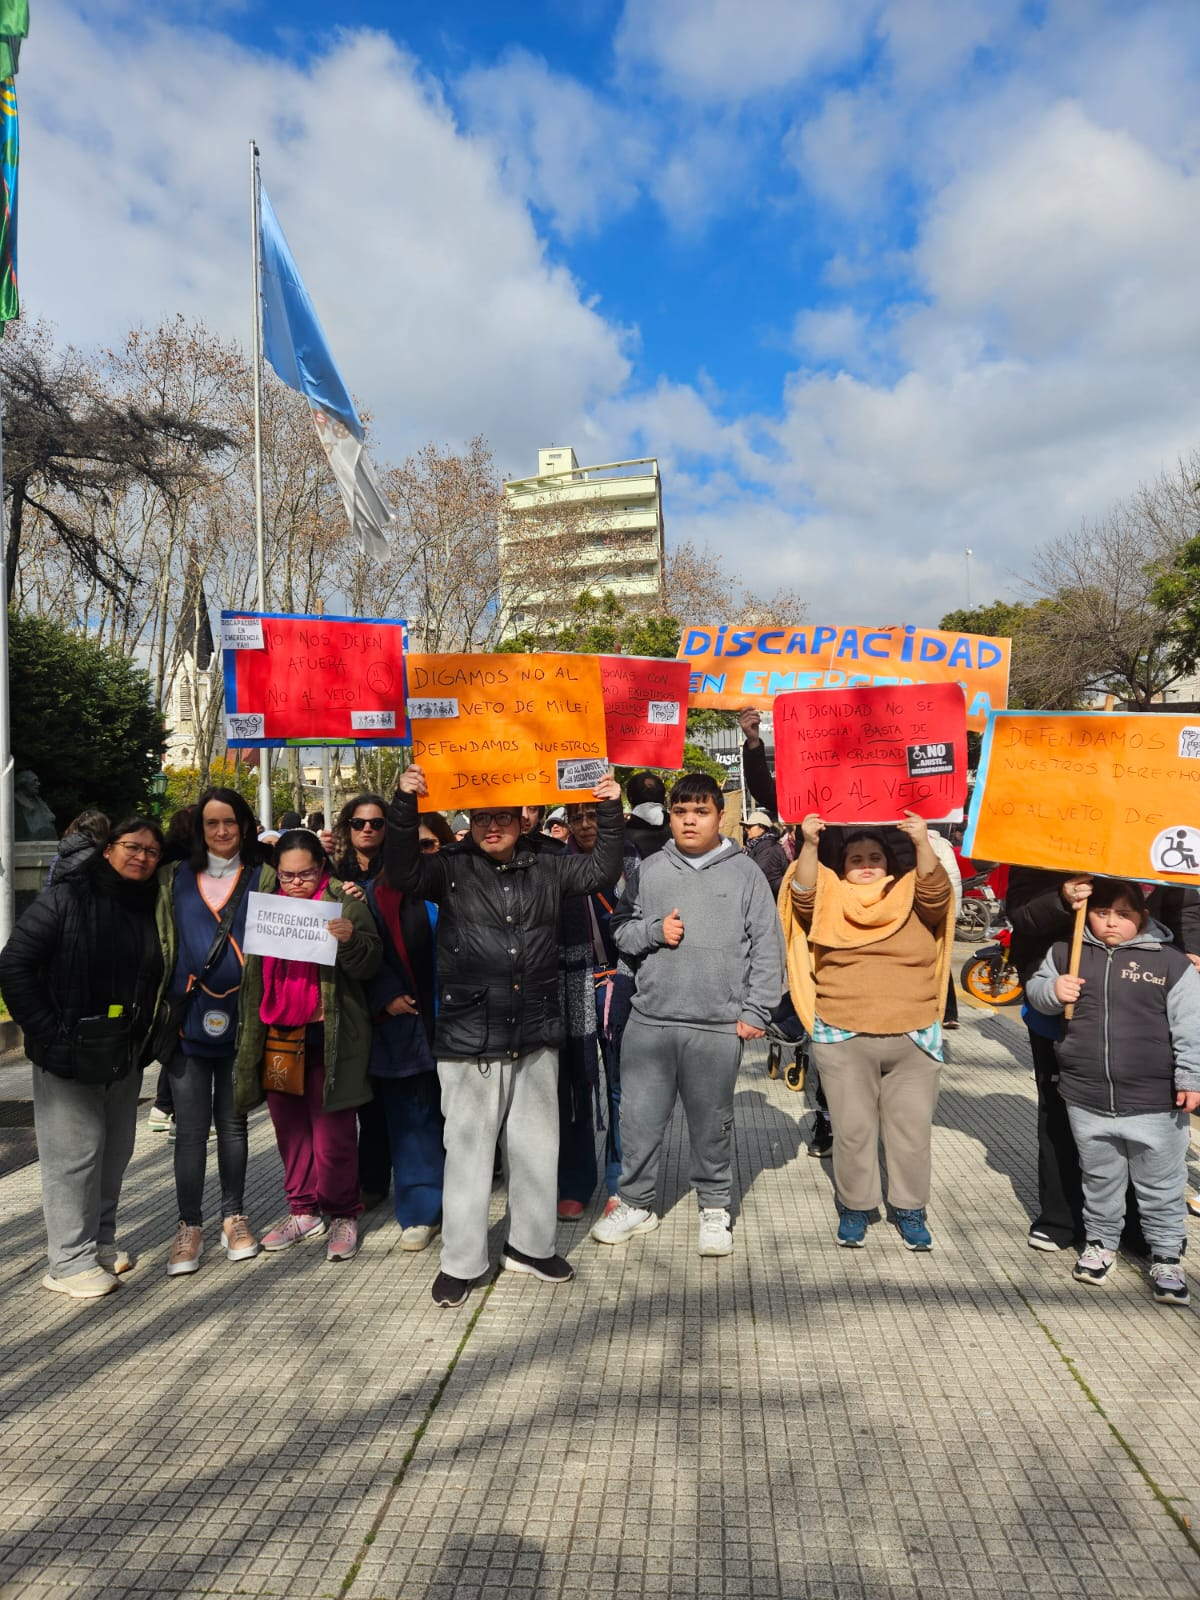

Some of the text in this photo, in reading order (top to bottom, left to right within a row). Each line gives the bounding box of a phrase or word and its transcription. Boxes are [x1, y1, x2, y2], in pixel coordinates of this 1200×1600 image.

[299, 631, 330, 649] NOS
[342, 632, 383, 654] DEJEN
[288, 656, 348, 675] AFUERA
[413, 667, 579, 690] DIGAMOS NO AL
[647, 672, 669, 686] CON
[268, 684, 288, 706] NO
[301, 690, 315, 708] AL
[628, 687, 676, 700] EXISTIMOS
[461, 700, 505, 716] VETO
[514, 700, 536, 713] DE
[782, 701, 935, 722] LA DIGNIDAD NO SE
[861, 723, 903, 738] BASTA
[910, 723, 927, 735] DE
[1003, 726, 1167, 750] DEFENDAMOS
[413, 740, 601, 758] DEFENDAMOS NUESTROS
[800, 750, 840, 762] TANTA
[926, 744, 946, 758] NO
[1005, 757, 1099, 776] NUESTROS
[451, 768, 551, 789] DERECHOS
[848, 779, 871, 805] AL
[986, 802, 1164, 825] NO AL VETO DE
[257, 909, 320, 929] EMERGENCIA
[256, 922, 329, 942] DISCAPACIDAD
